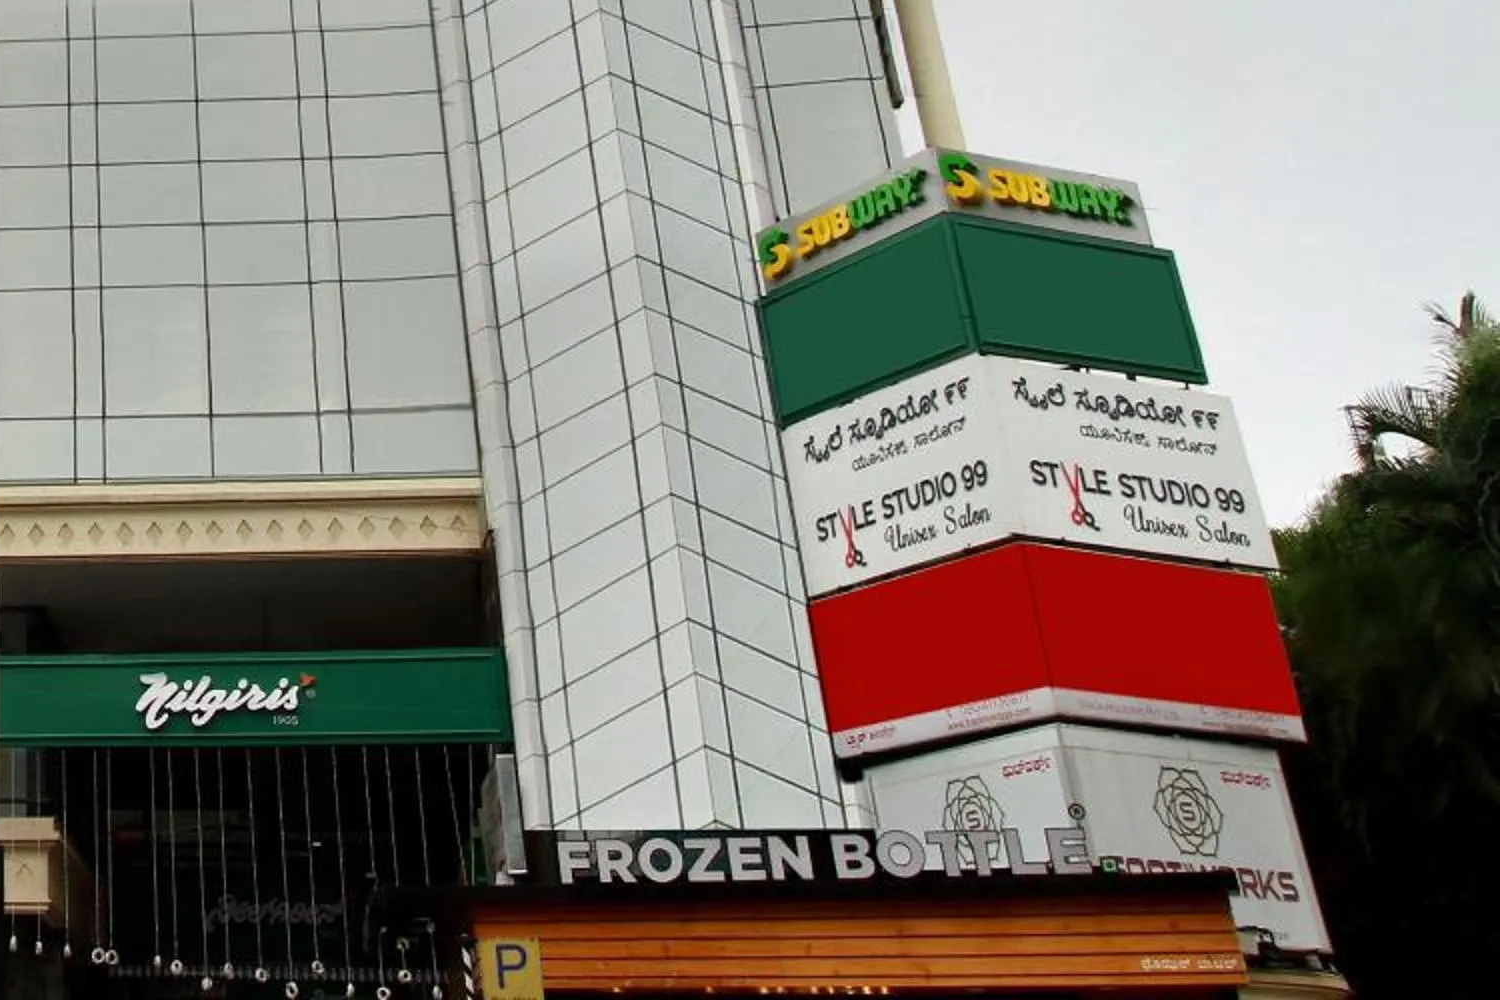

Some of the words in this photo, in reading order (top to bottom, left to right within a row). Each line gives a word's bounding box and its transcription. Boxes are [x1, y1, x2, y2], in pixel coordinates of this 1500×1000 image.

[797, 169, 924, 260] SUBWAY
[988, 167, 1130, 221] SUBWAY
[816, 499, 877, 556] STYLE
[882, 471, 957, 519] STUDIO
[961, 459, 989, 491] 99
[1029, 459, 1112, 512] STYLE
[1117, 473, 1211, 509] STUDIO
[1214, 487, 1246, 514] 99
[884, 525, 937, 552] Unisex
[943, 503, 993, 535] Salon
[1124, 503, 1190, 538] Unisex
[1195, 515, 1251, 547] Salon
[136, 672, 299, 729] Nilgiris
[558, 836, 814, 884] FROZEN
[831, 827, 1093, 880] BOTTLE
[496, 944, 527, 990] P
